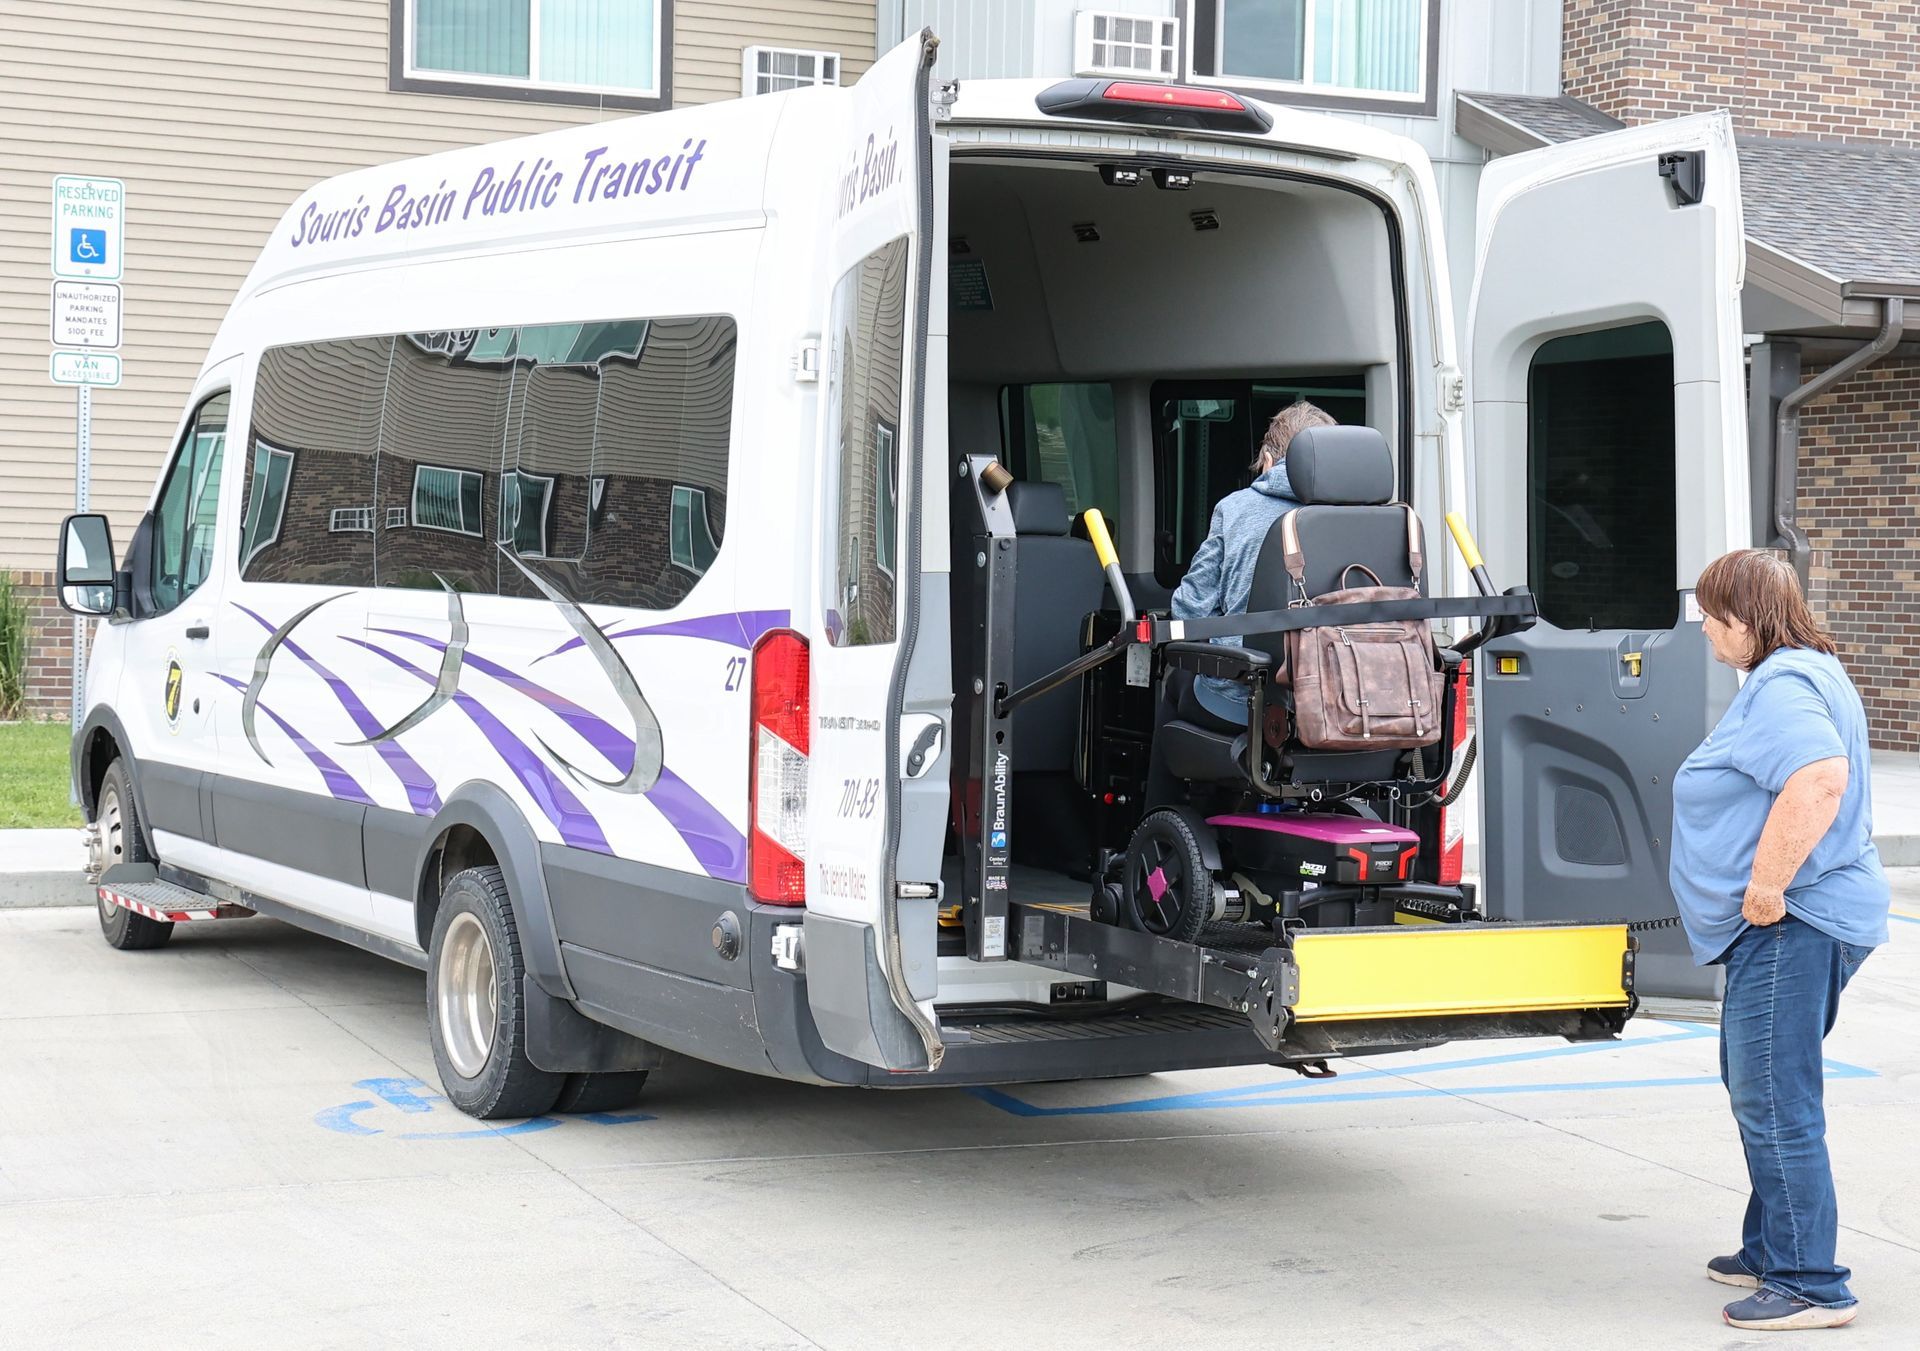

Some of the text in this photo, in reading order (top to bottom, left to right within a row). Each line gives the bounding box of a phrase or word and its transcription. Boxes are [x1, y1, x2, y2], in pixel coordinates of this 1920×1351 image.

[859, 124, 898, 205] Basin
[58, 186, 119, 202] RESERVED
[291, 138, 707, 248] Souris Basin Public Transit
[63, 203, 114, 219] PARKING
[56, 292, 118, 303] UNAUTHORIZED
[69, 304, 104, 314] PARKING
[65, 316, 108, 326] MANDATES
[68, 327, 105, 337] $100 FEE
[75, 360, 99, 370] VAN
[61, 370, 112, 380] ACCESSIBLE
[725, 656, 747, 693] 27
[992, 750, 1010, 831] BraunAbility
[1299, 860, 1327, 875] Jazzy
